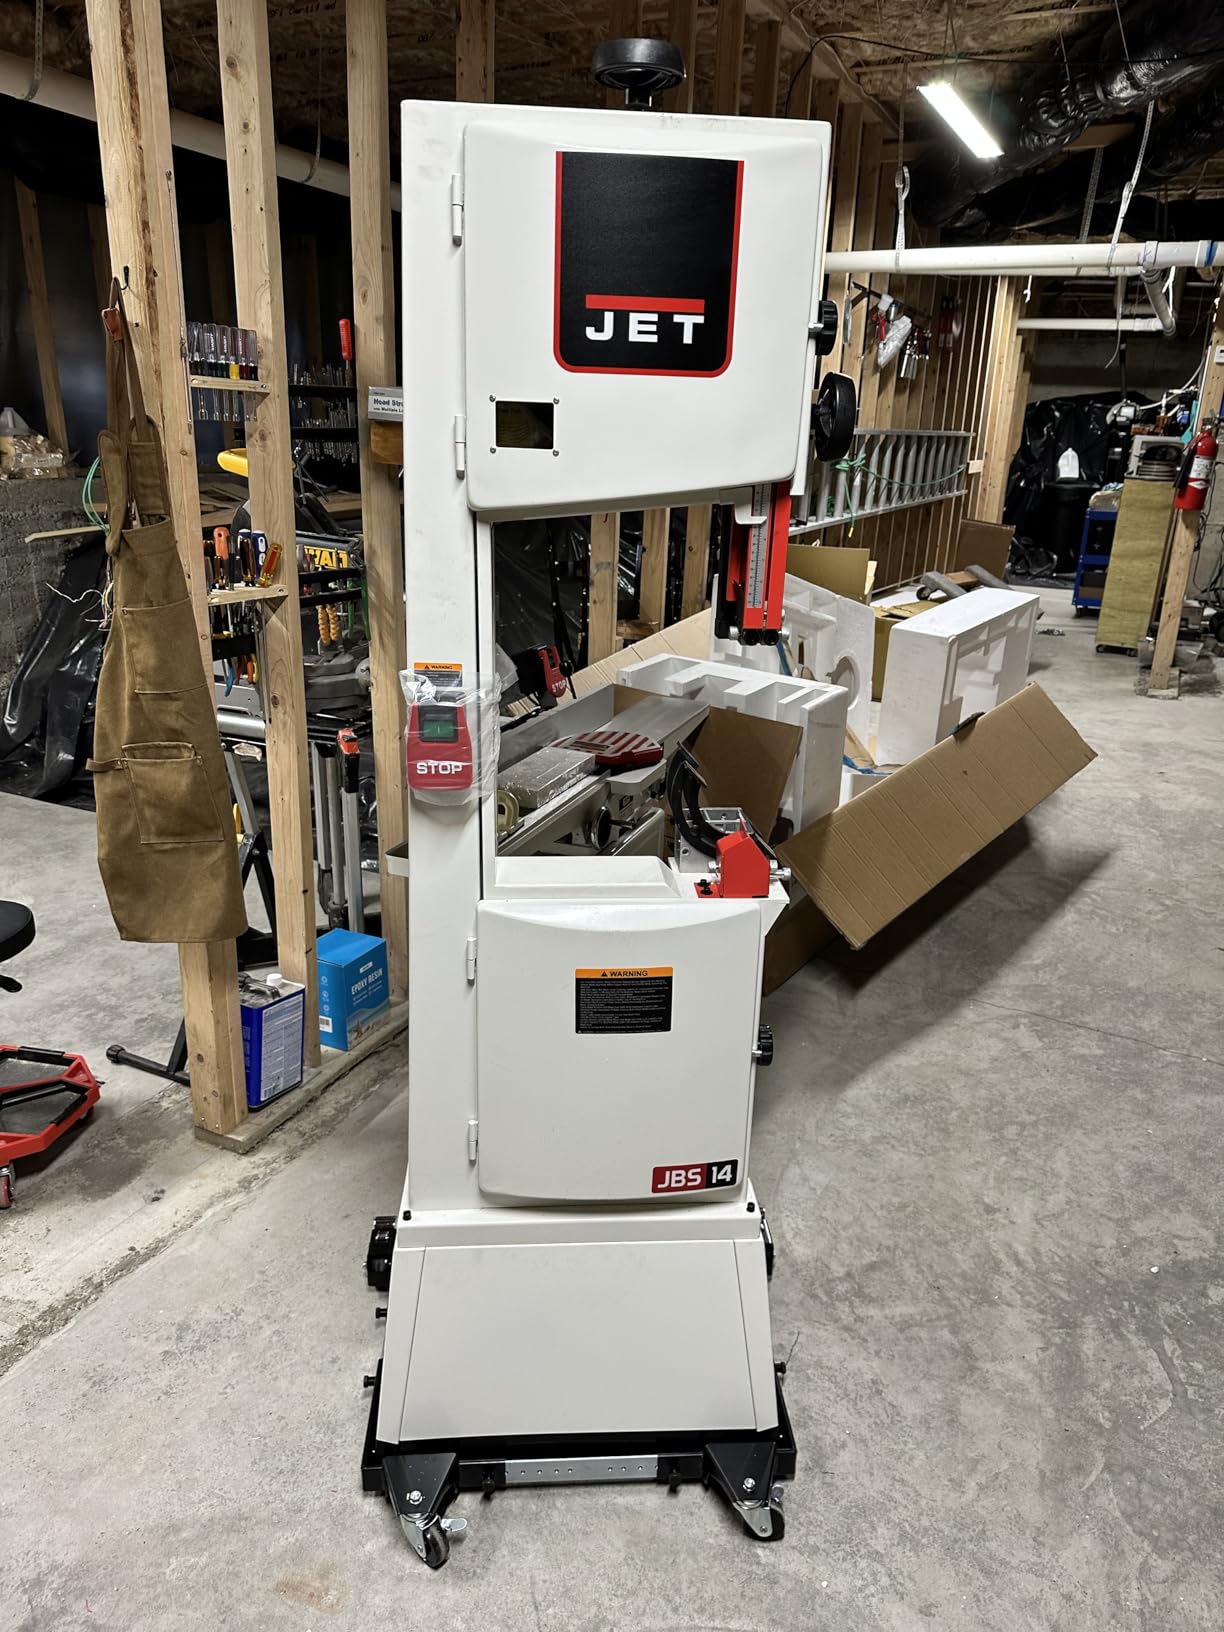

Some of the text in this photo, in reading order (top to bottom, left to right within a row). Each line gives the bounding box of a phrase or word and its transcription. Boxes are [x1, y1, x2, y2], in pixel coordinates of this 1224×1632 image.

[585, 311, 705, 344] JET
[551, 679, 567, 693] STOP
[416, 762, 463, 775] STOP
[609, 970, 649, 978] WARNING
[351, 977, 368, 994] EPOXY
[657, 1164, 733, 1189] JBS 14
